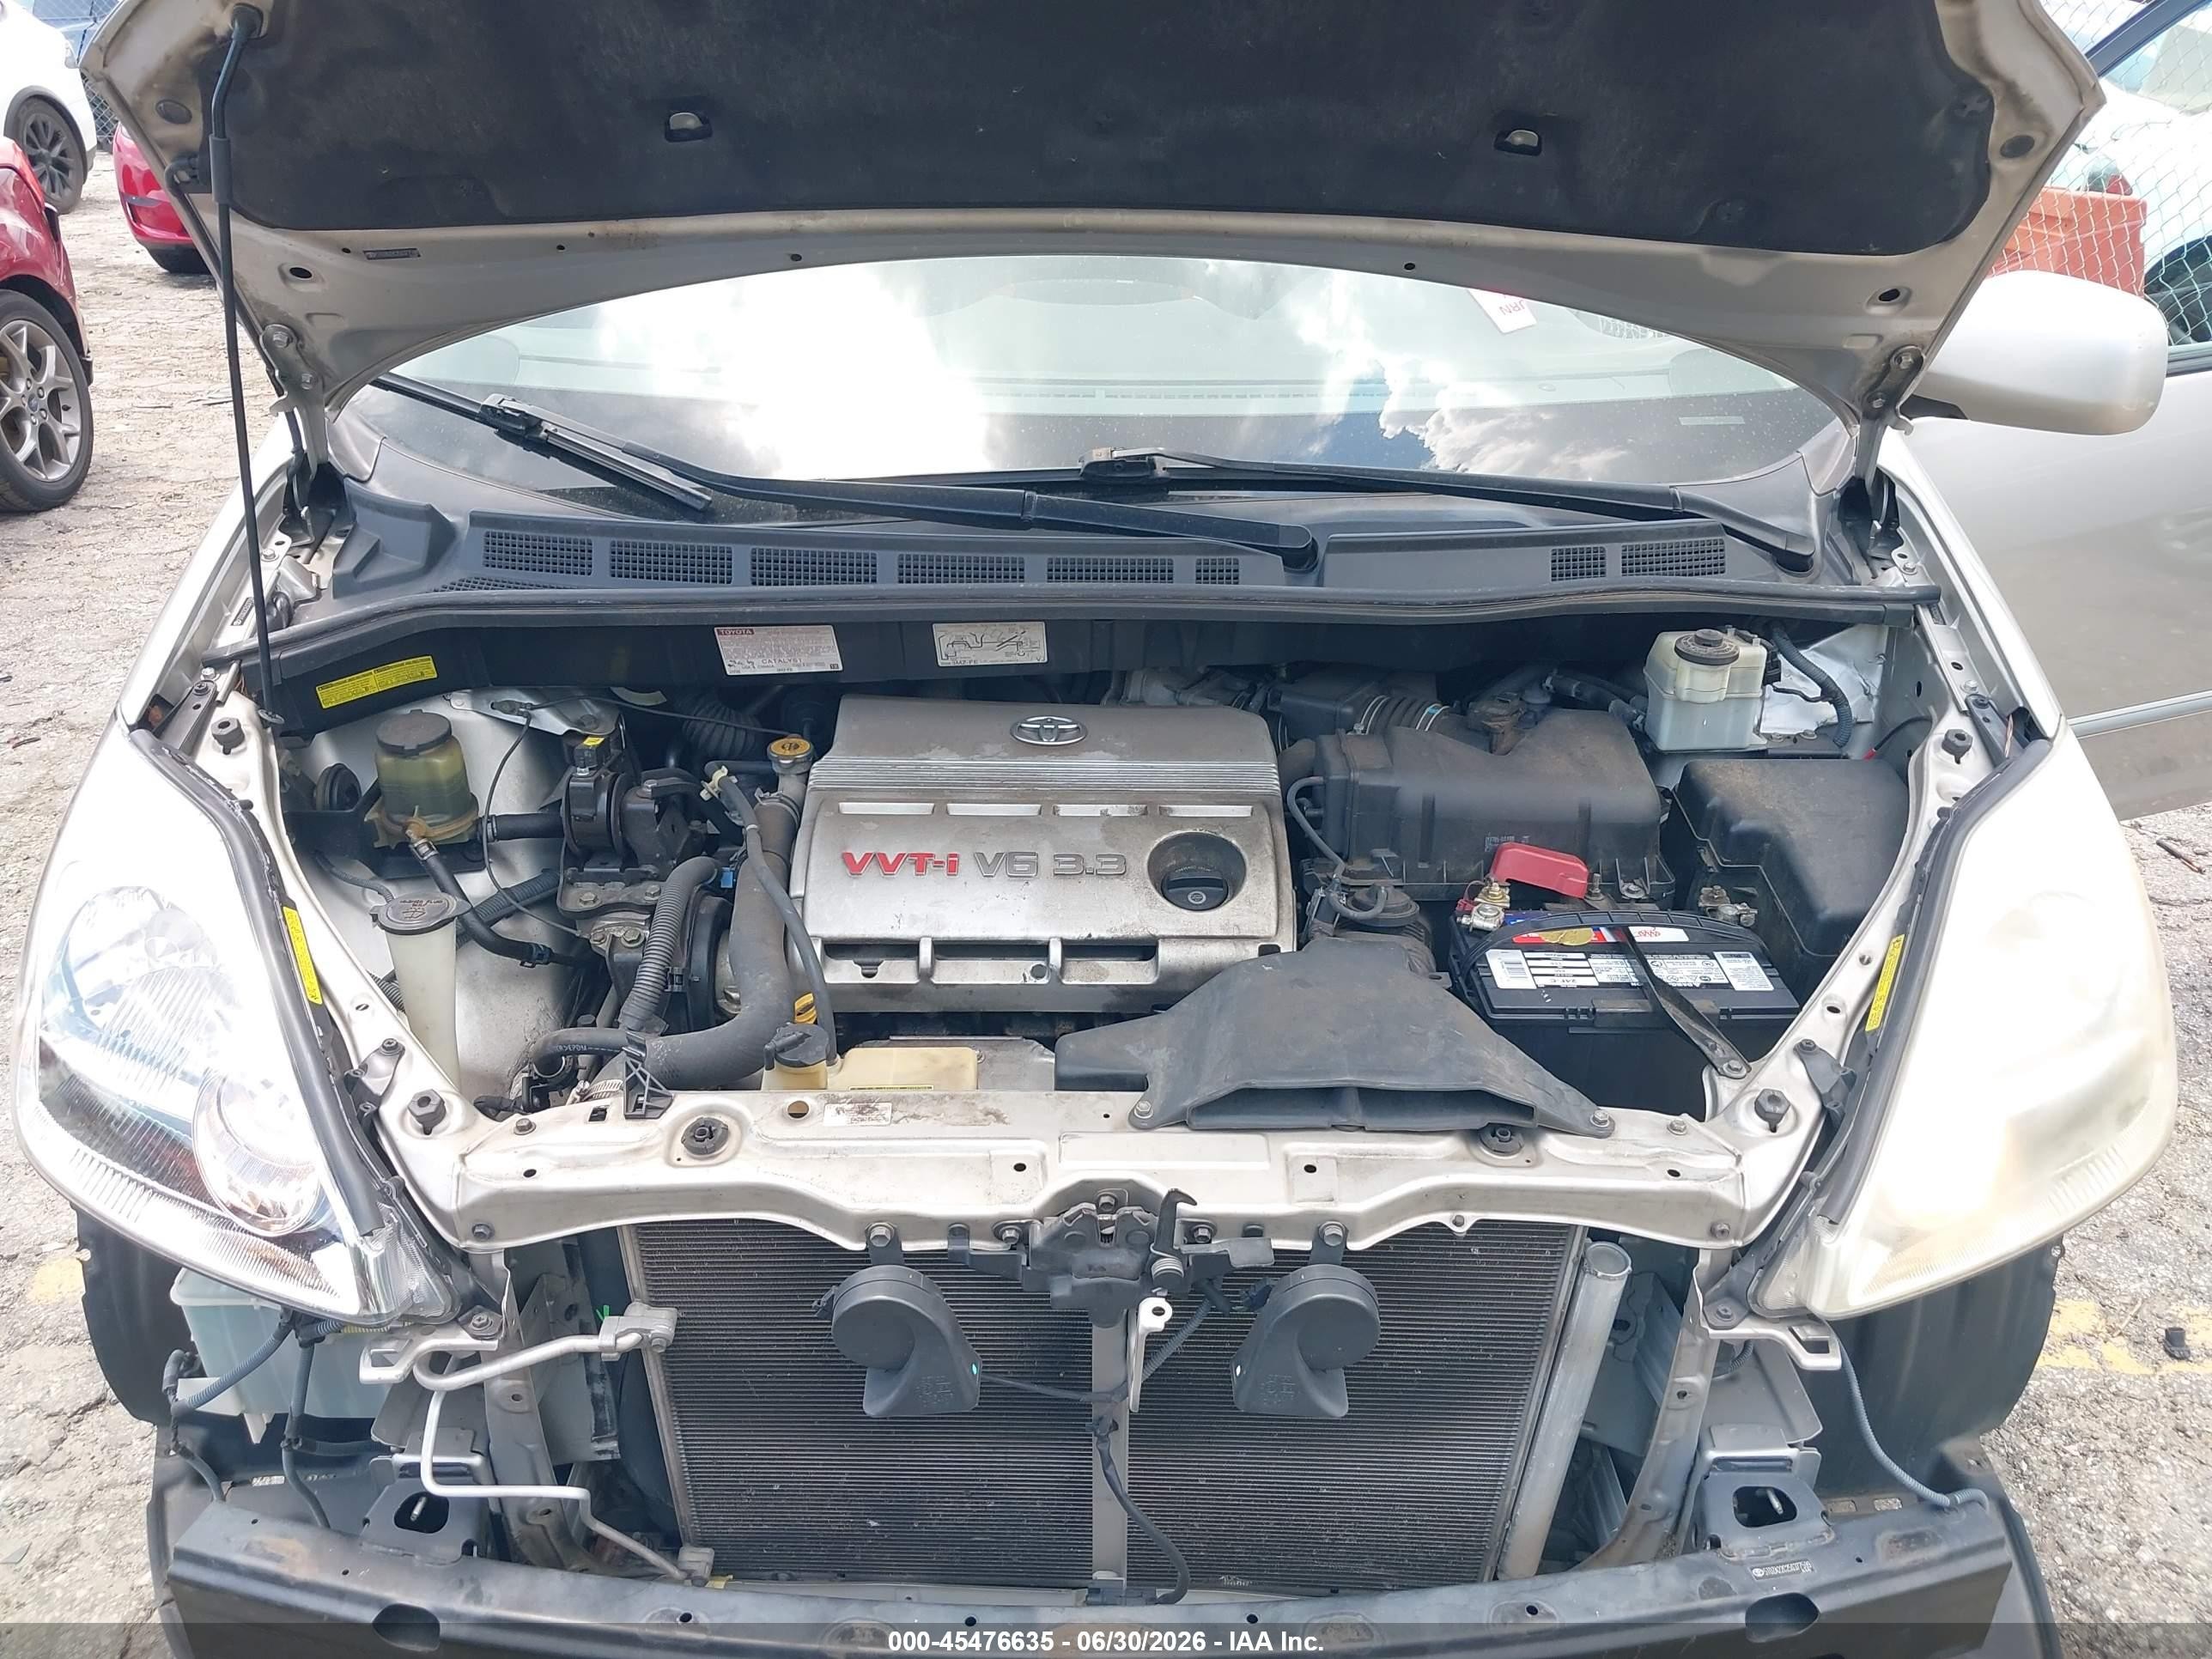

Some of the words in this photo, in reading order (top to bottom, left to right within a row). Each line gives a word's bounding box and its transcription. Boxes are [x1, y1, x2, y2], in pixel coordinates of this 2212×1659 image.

[842, 852, 960, 877] VVT-i
[975, 851, 1038, 878] V6
[1053, 853, 1127, 877] 3.3
